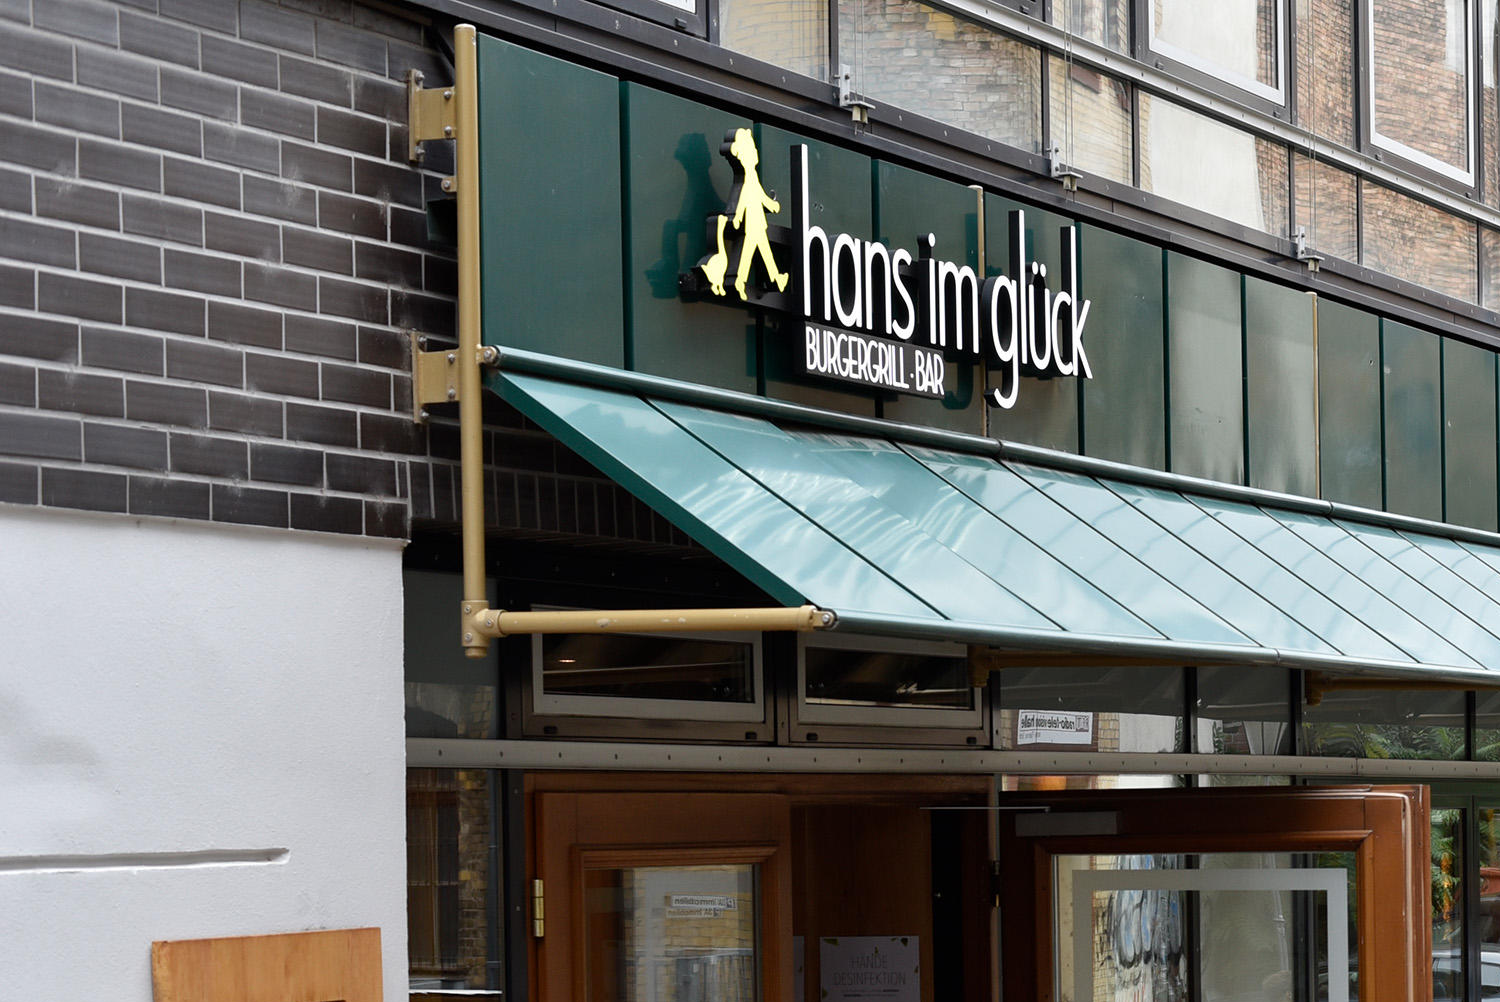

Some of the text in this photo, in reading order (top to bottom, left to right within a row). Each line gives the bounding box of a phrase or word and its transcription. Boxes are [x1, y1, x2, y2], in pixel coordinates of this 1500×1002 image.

[801, 143, 1094, 409] hans im glück
[805, 326, 945, 396] BURGERGRILL BAR
